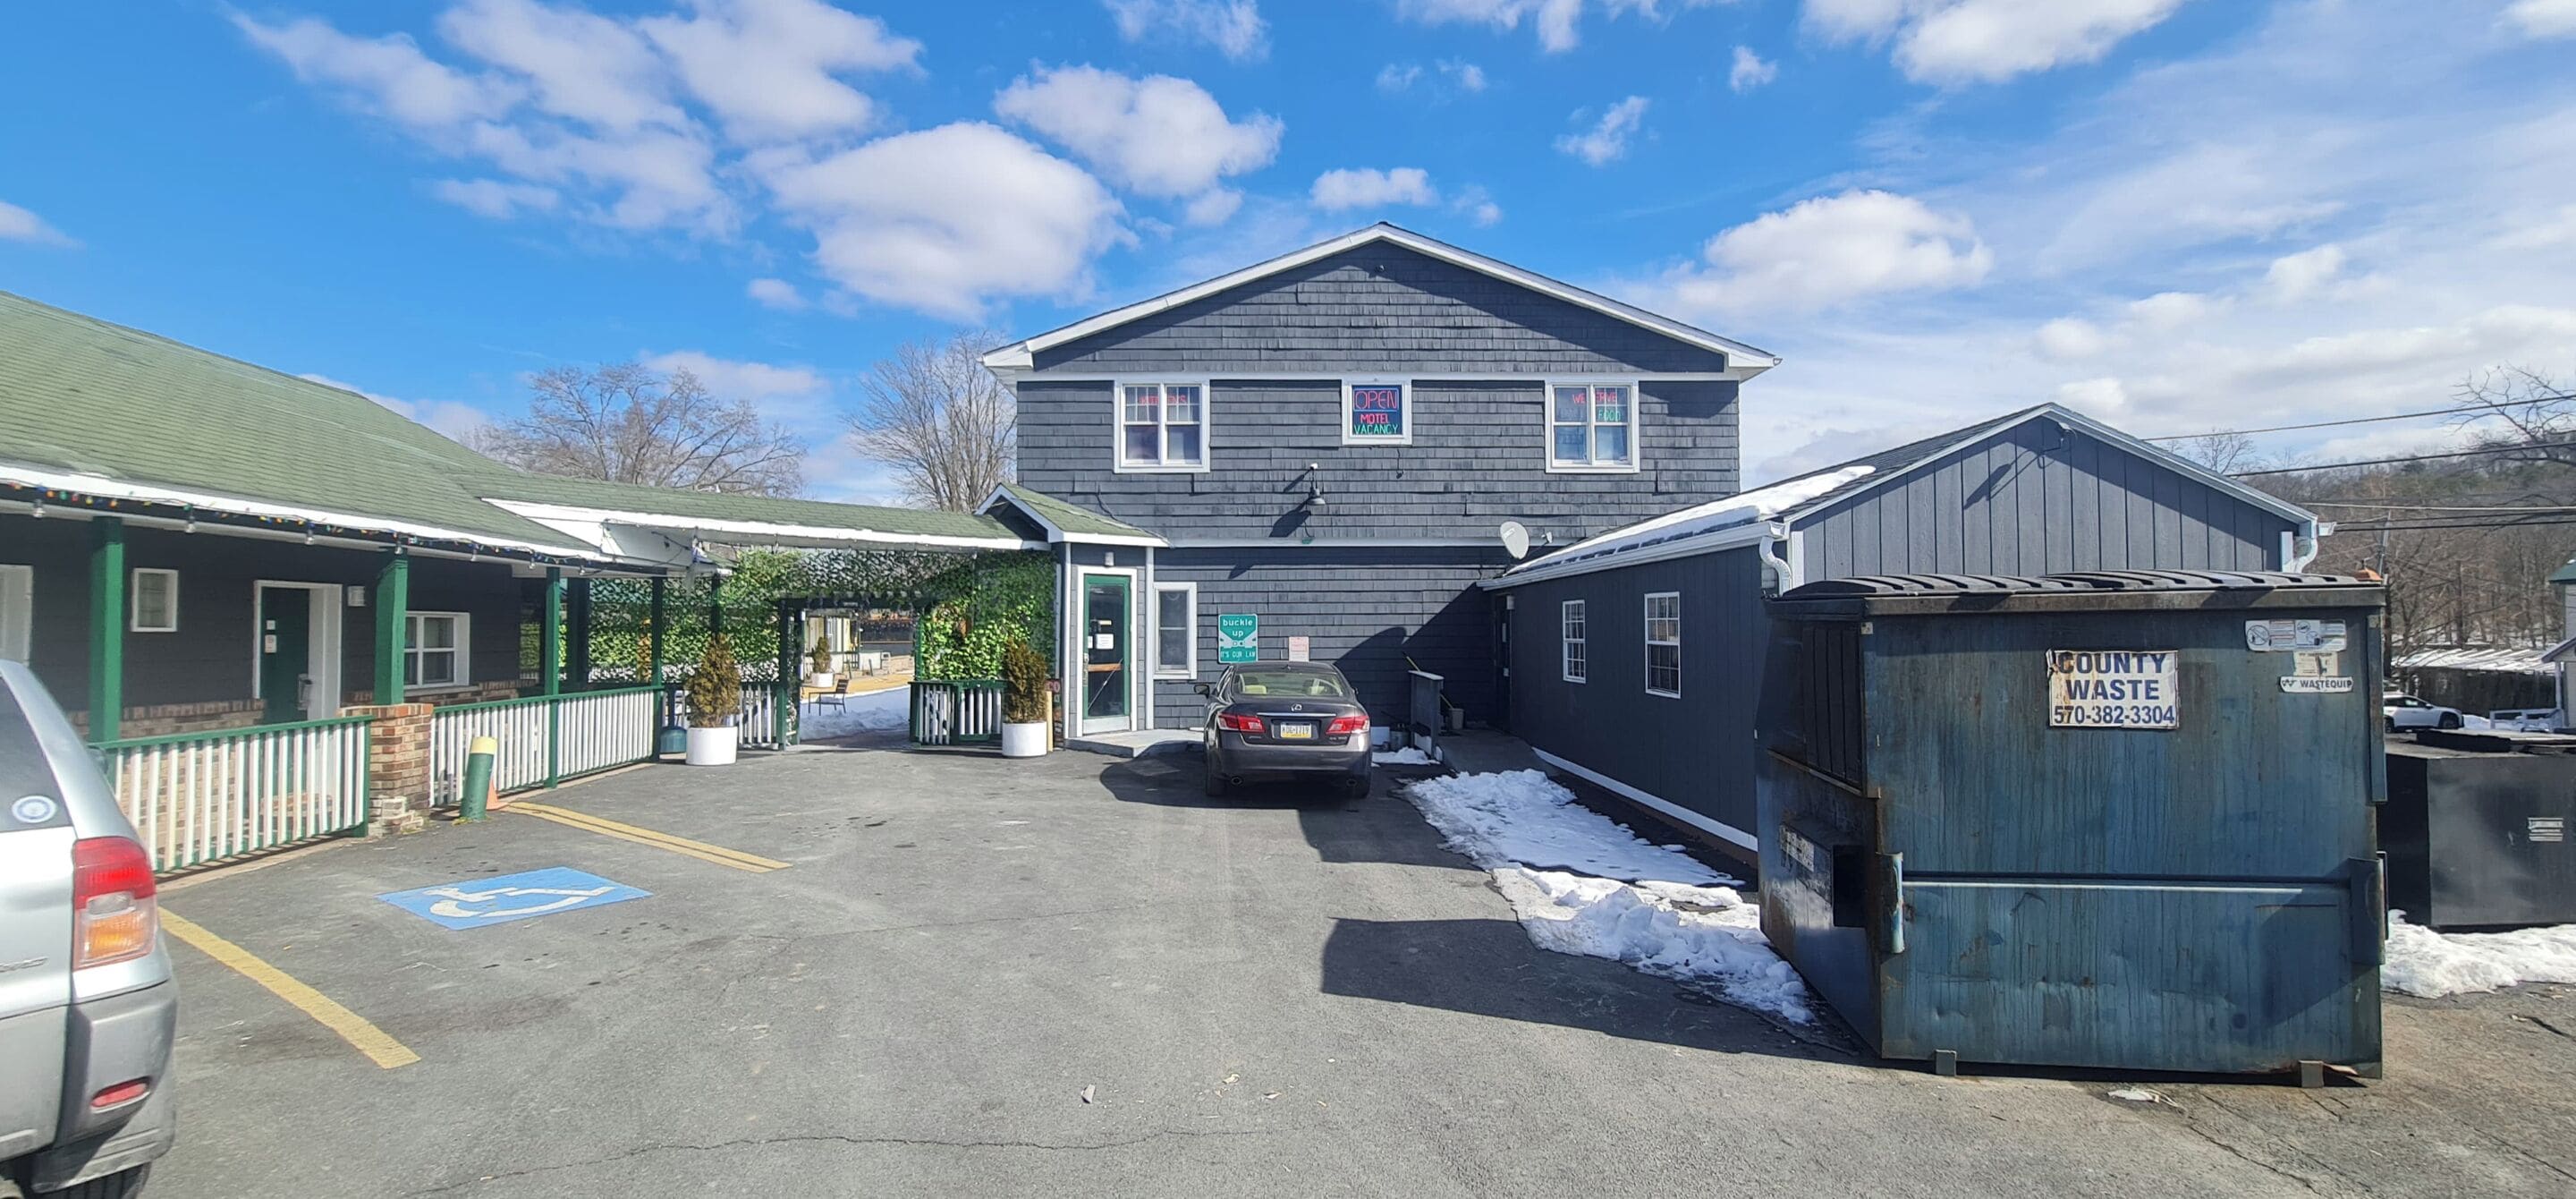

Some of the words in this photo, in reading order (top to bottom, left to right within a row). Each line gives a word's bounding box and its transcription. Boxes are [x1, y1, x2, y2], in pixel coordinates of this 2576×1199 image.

[1355, 390, 1397, 409] OPEN
[1572, 394, 1586, 404] WE
[1360, 413, 1389, 423] MOTEL
[1598, 409, 1621, 421] FOOD
[1354, 424, 1398, 434] VACANCY
[1223, 618, 1253, 626] buckle
[1232, 630, 1244, 638] up
[2057, 651, 2166, 674] COUNTY
[2300, 680, 2352, 689] WASTEQUIP
[2066, 679, 2160, 701] WASTE
[2054, 704, 2175, 725] 570-382-3304
